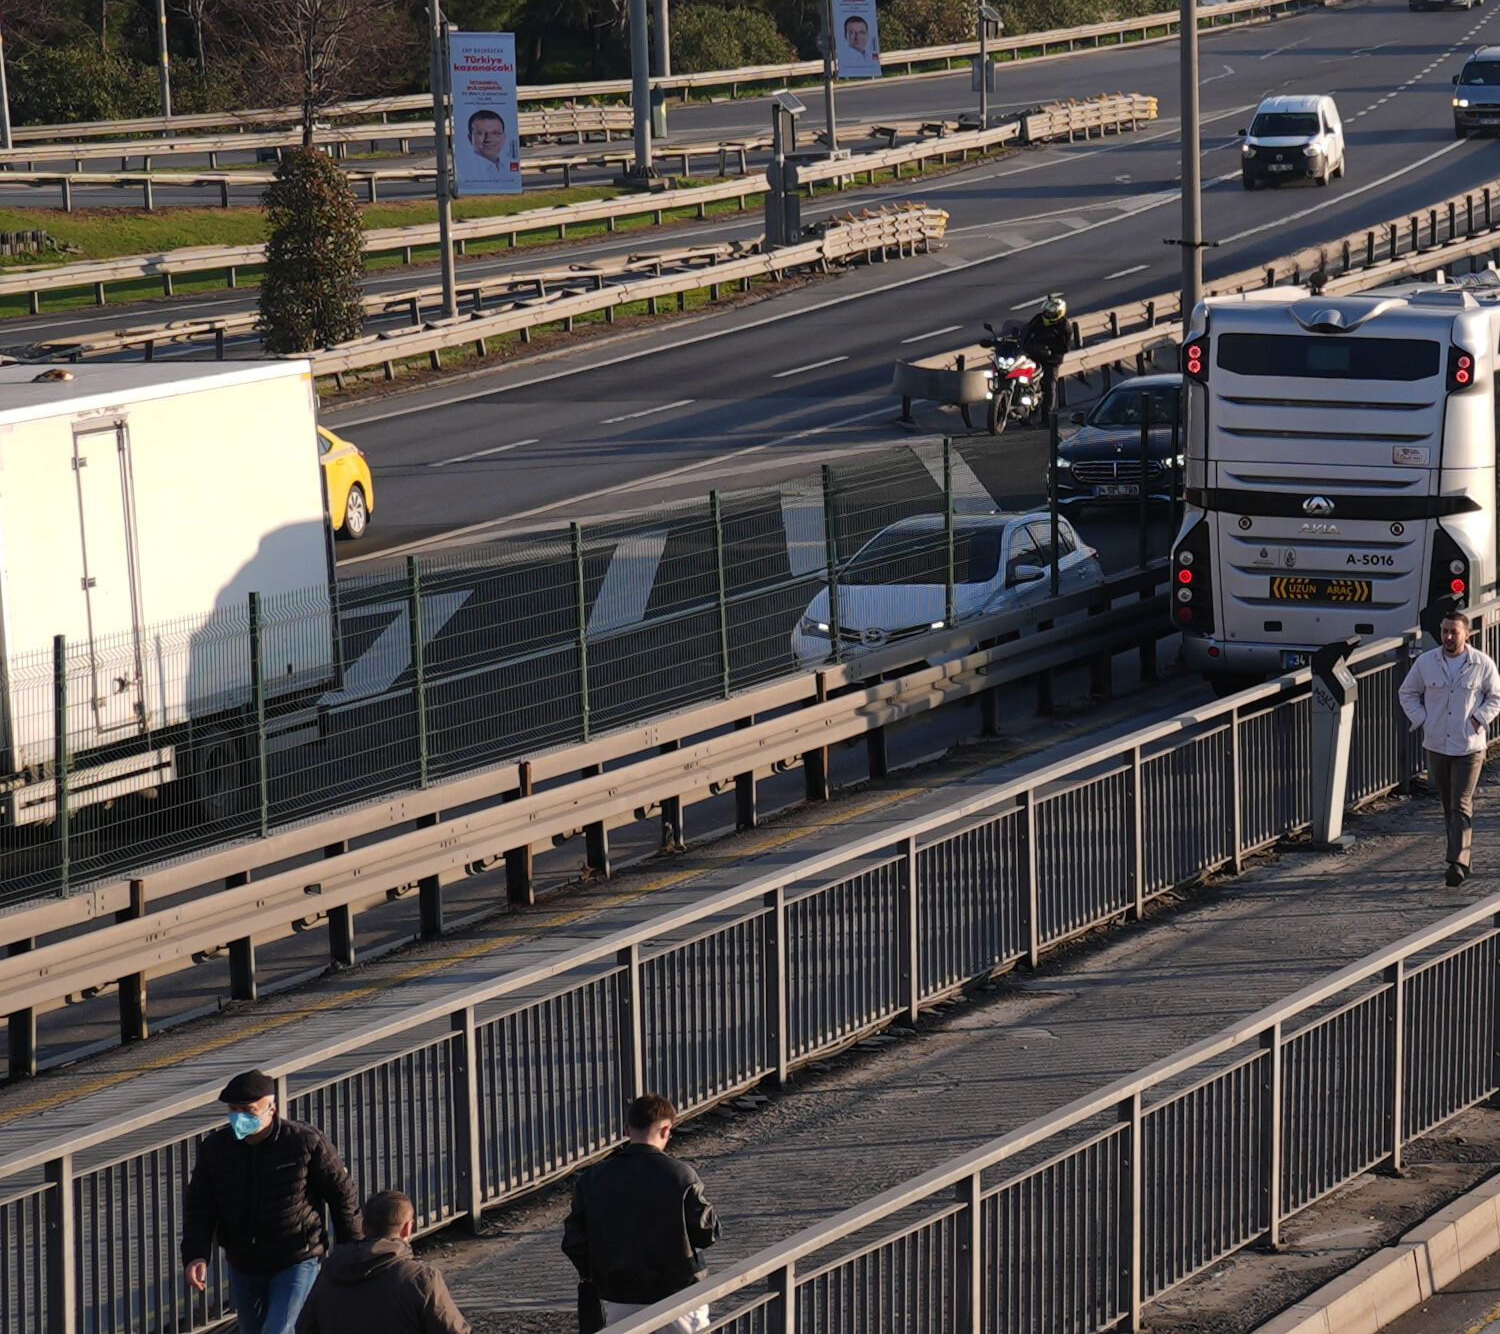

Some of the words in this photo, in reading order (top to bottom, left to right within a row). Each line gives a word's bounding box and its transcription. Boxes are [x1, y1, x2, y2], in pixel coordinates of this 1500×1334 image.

[464, 56, 502, 65] Türkiye
[454, 64, 513, 72] kazanacak!
[1300, 524, 1339, 534] AKIA
[1345, 554, 1394, 567] A-5016
[1288, 584, 1316, 594] UZUN
[1326, 585, 1354, 597] ARAÇ
[1294, 654, 1305, 666] 34
